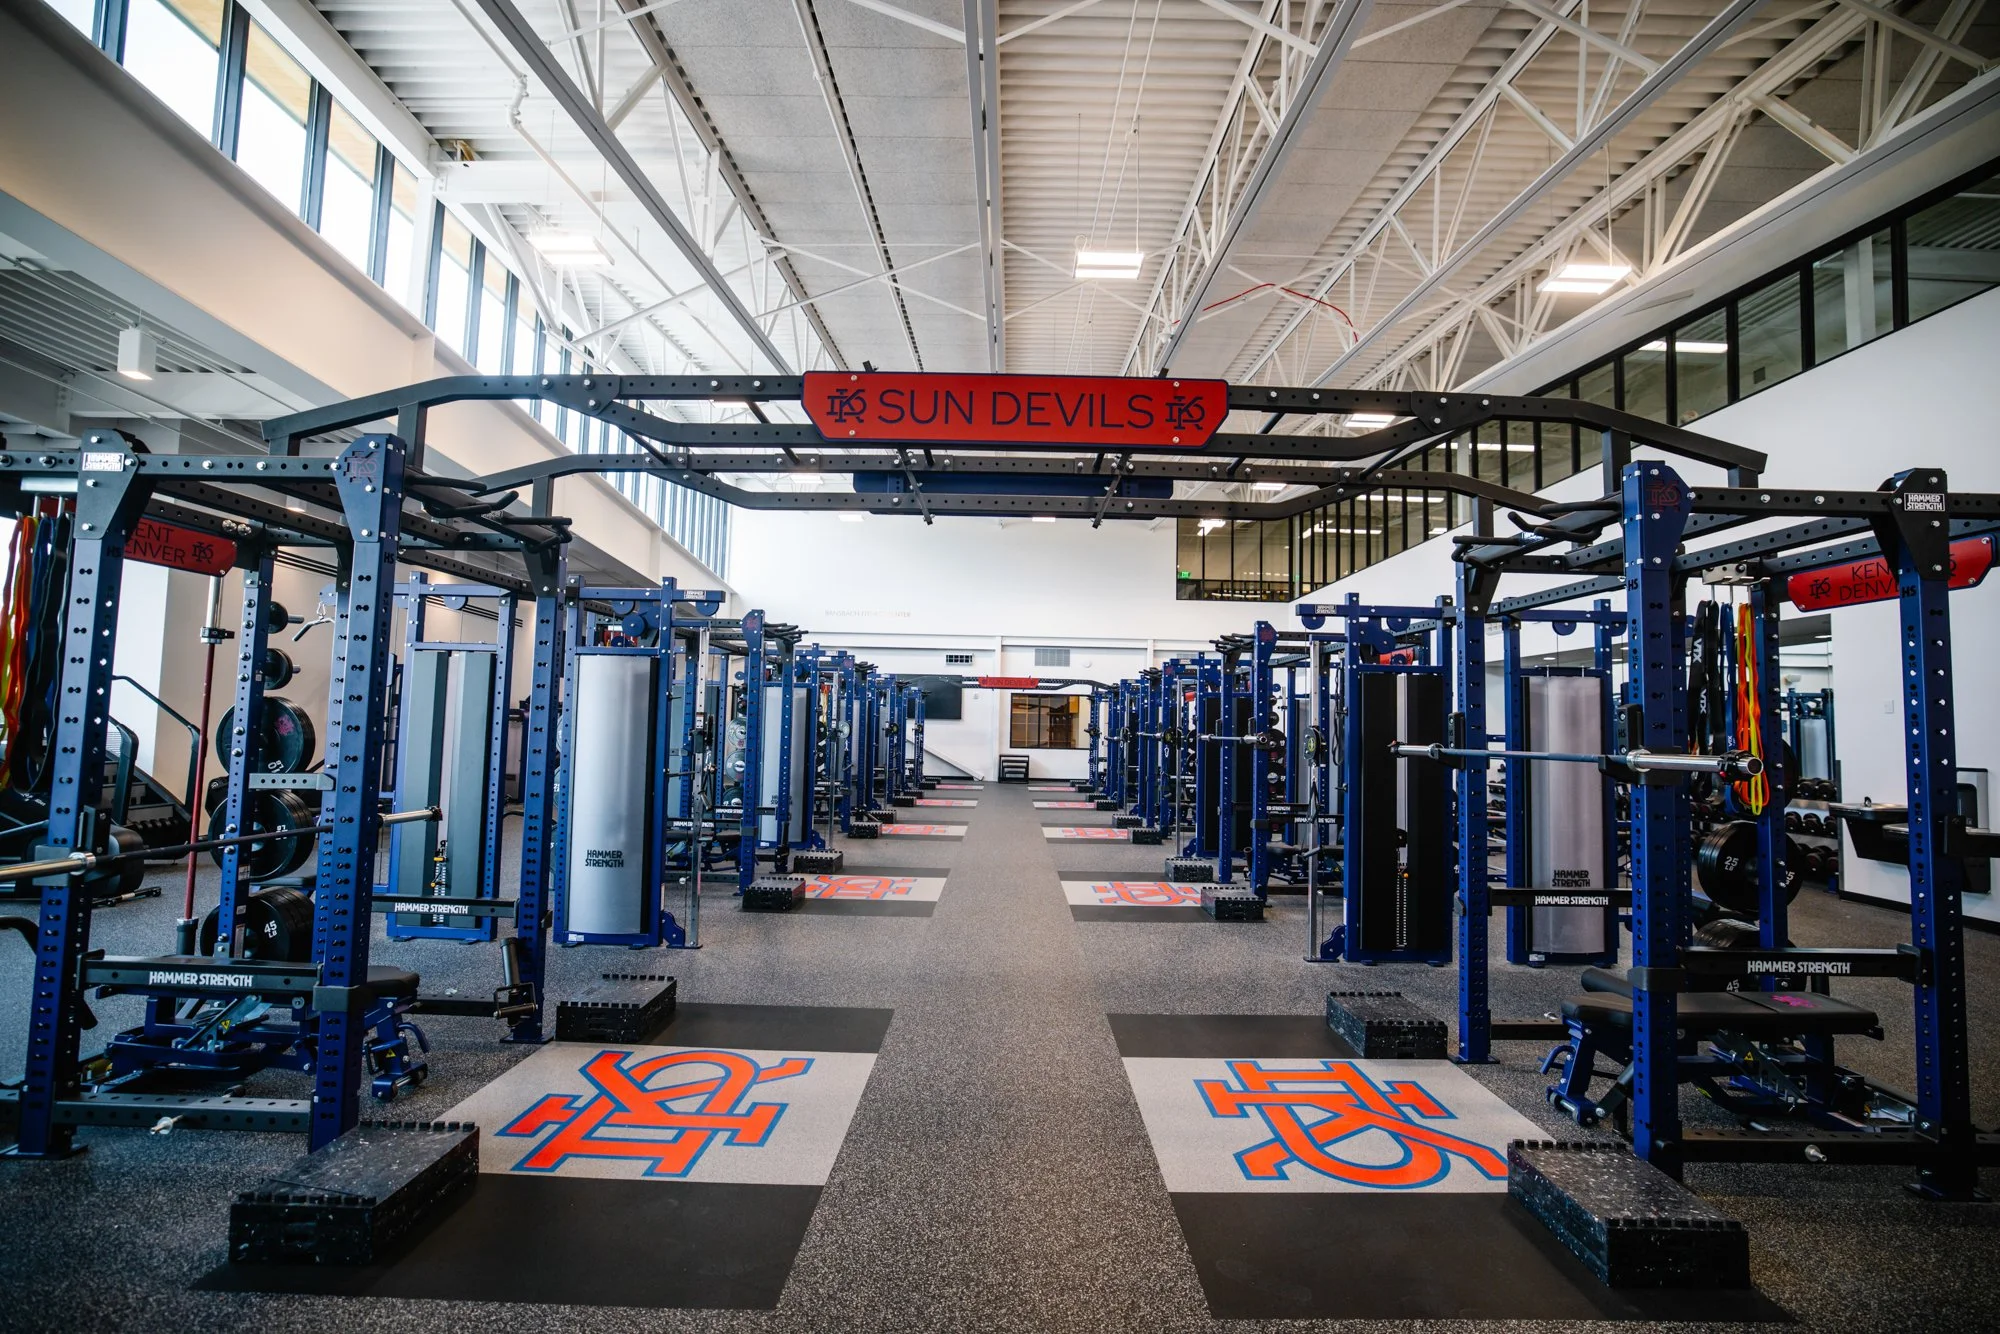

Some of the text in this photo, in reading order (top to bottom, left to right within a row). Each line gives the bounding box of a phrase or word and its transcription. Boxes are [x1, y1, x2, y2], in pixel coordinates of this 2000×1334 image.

[877, 388, 973, 425] SUN
[991, 391, 1154, 429] DEVILS
[1908, 494, 1940, 502] HAMMER
[1907, 502, 1942, 510] STRENGTH
[135, 522, 174, 543] ENT
[124, 541, 186, 564] ENVER
[383, 552, 394, 563] HS
[1852, 561, 1889, 582] KEN
[1628, 579, 1638, 590] HS
[1839, 579, 1899, 601] DENV
[1902, 586, 1916, 598] HS
[1693, 638, 1702, 663] VTX
[587, 849, 622, 859] HAMMER
[585, 858, 624, 867] STRENGTH
[1724, 856, 1739, 867] 25
[1553, 870, 1589, 879] HAMMER
[1552, 879, 1590, 887] STRENGTH
[1535, 896, 1609, 905] HAMMER STRENGTH
[394, 903, 469, 914] HAMMER STRENGTH
[264, 921, 277, 933] 45
[268, 930, 277, 938] LB
[1747, 961, 1850, 974] HAMMER STRENGTH
[149, 971, 253, 987] HAMMER STRENGTH
[1726, 979, 1739, 991] 45
